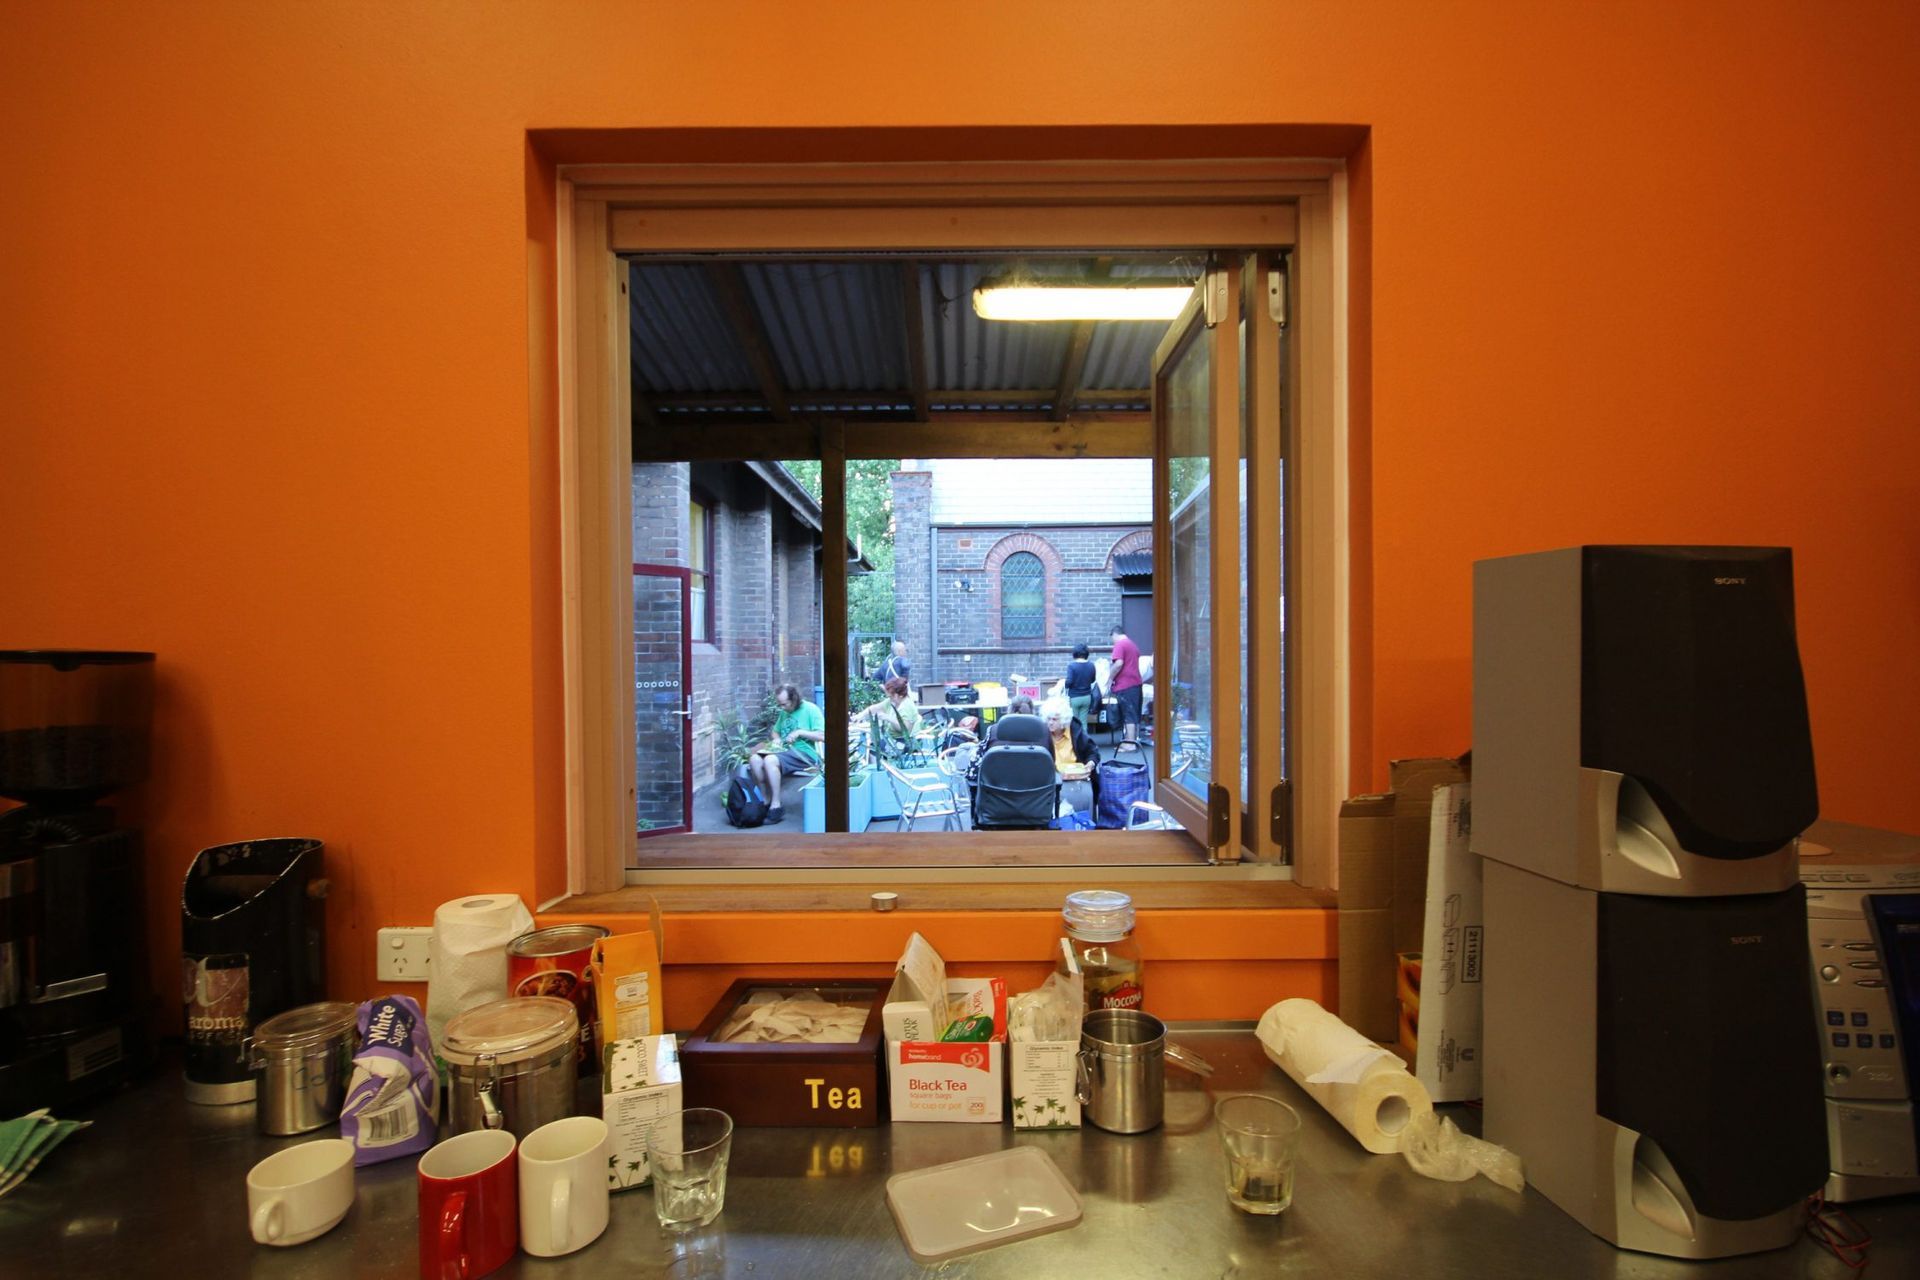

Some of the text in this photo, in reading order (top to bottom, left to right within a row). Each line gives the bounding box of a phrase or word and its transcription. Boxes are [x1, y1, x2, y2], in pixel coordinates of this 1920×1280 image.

[1713, 577, 1747, 585] SONY
[188, 1015, 246, 1030] aroma
[367, 1004, 396, 1046] White
[903, 1017, 911, 1040] OTUS
[909, 1078, 967, 1091] Black Tea
[804, 1078, 862, 1109] Tea
[935, 1092, 952, 1100] bags
[910, 1101, 921, 1109] for
[921, 1102, 937, 1111] cup
